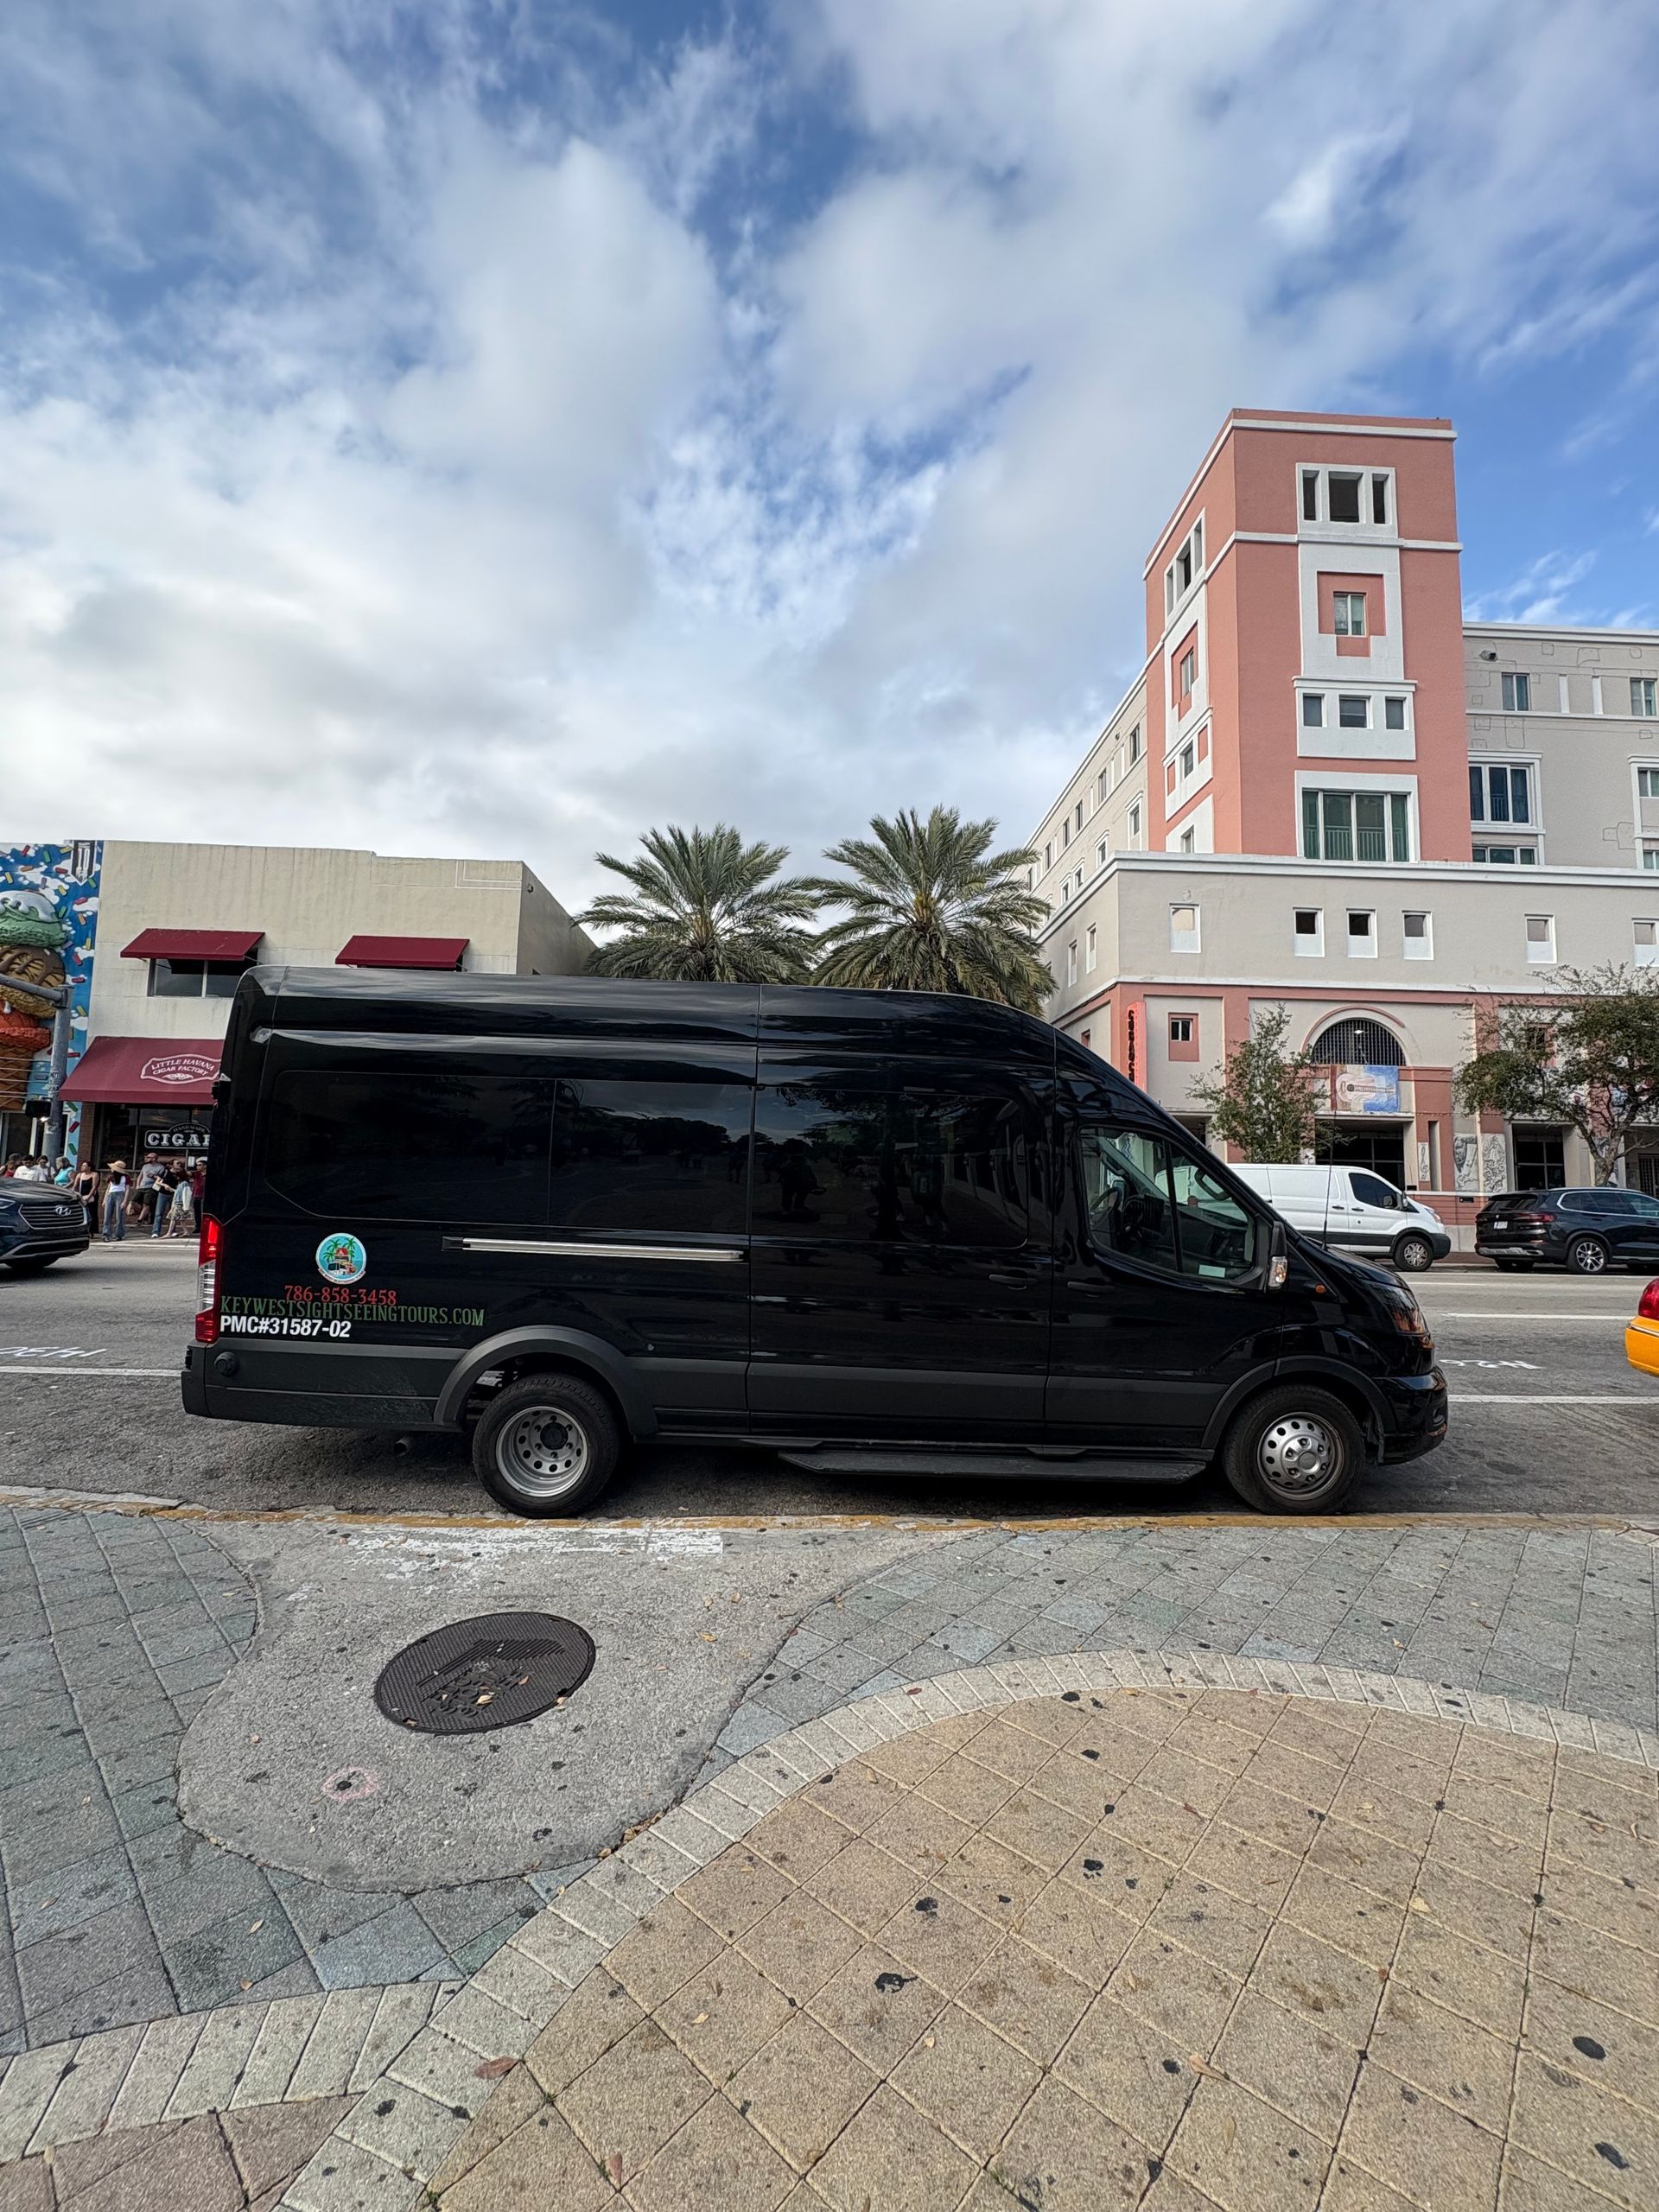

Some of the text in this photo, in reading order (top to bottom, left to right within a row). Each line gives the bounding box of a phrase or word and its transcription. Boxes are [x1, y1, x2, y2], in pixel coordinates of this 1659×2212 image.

[151, 1058, 215, 1071] LITTLE HAVANA
[152, 1065, 209, 1077] CIGAR FACTORY
[284, 1285, 397, 1306] 786-858-3458
[219, 1295, 486, 1326] KEYWESTSIGHTSEEINGTOURS.COM
[219, 1315, 352, 1338] PMC#31587-02
